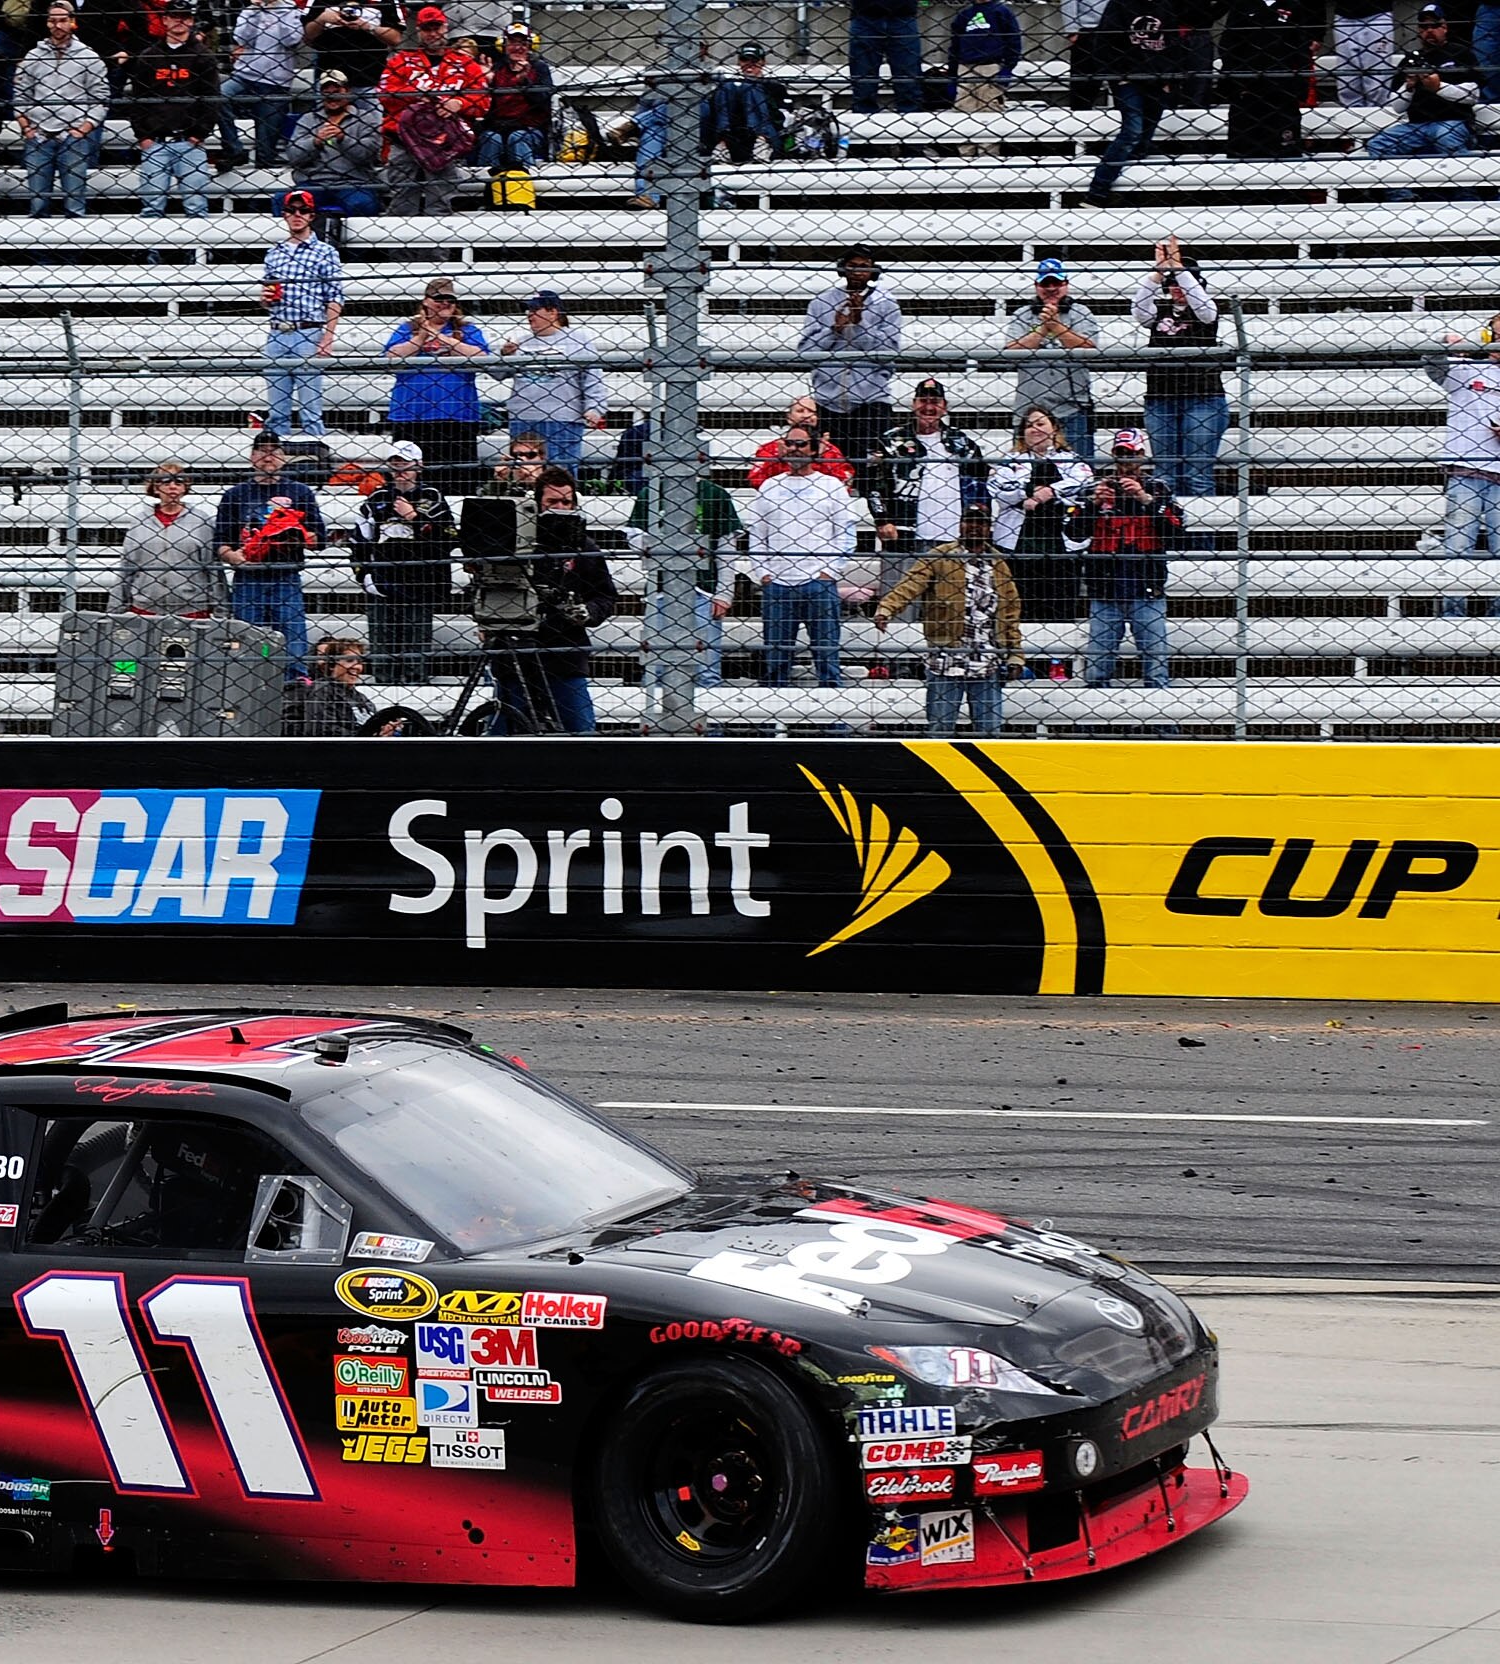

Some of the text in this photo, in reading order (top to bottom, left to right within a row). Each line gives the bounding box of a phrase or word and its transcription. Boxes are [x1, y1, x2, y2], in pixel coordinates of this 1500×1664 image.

[388, 798, 771, 948] Sprint
[1165, 836, 1479, 919] CUP
[369, 1288, 404, 1303] Sprint
[391, 1306, 422, 1314] SERIES
[438, 1310, 519, 1325] MECHANIX WEAR
[524, 1294, 603, 1326] Holley
[524, 1316, 587, 1326] HP CARBS
[348, 1345, 399, 1353] POLE
[418, 1326, 465, 1365] USG
[470, 1328, 536, 1367] 3M
[340, 1360, 403, 1387] O'Reilly
[949, 1349, 998, 1385] 11
[13, 1270, 323, 1501] 11
[478, 1373, 545, 1386] LINCOLN
[494, 1388, 552, 1400] WELDERS
[359, 1400, 401, 1413] Auto
[1121, 1373, 1205, 1441] CAMRY
[358, 1412, 411, 1427] Meter
[423, 1414, 472, 1424] DIRECTV
[342, 1435, 428, 1463] JEGS
[432, 1444, 503, 1459] TISSOT
[866, 1440, 945, 1462] COMP
[866, 1475, 954, 1496] Edelbrock
[922, 1512, 969, 1547] WIX
